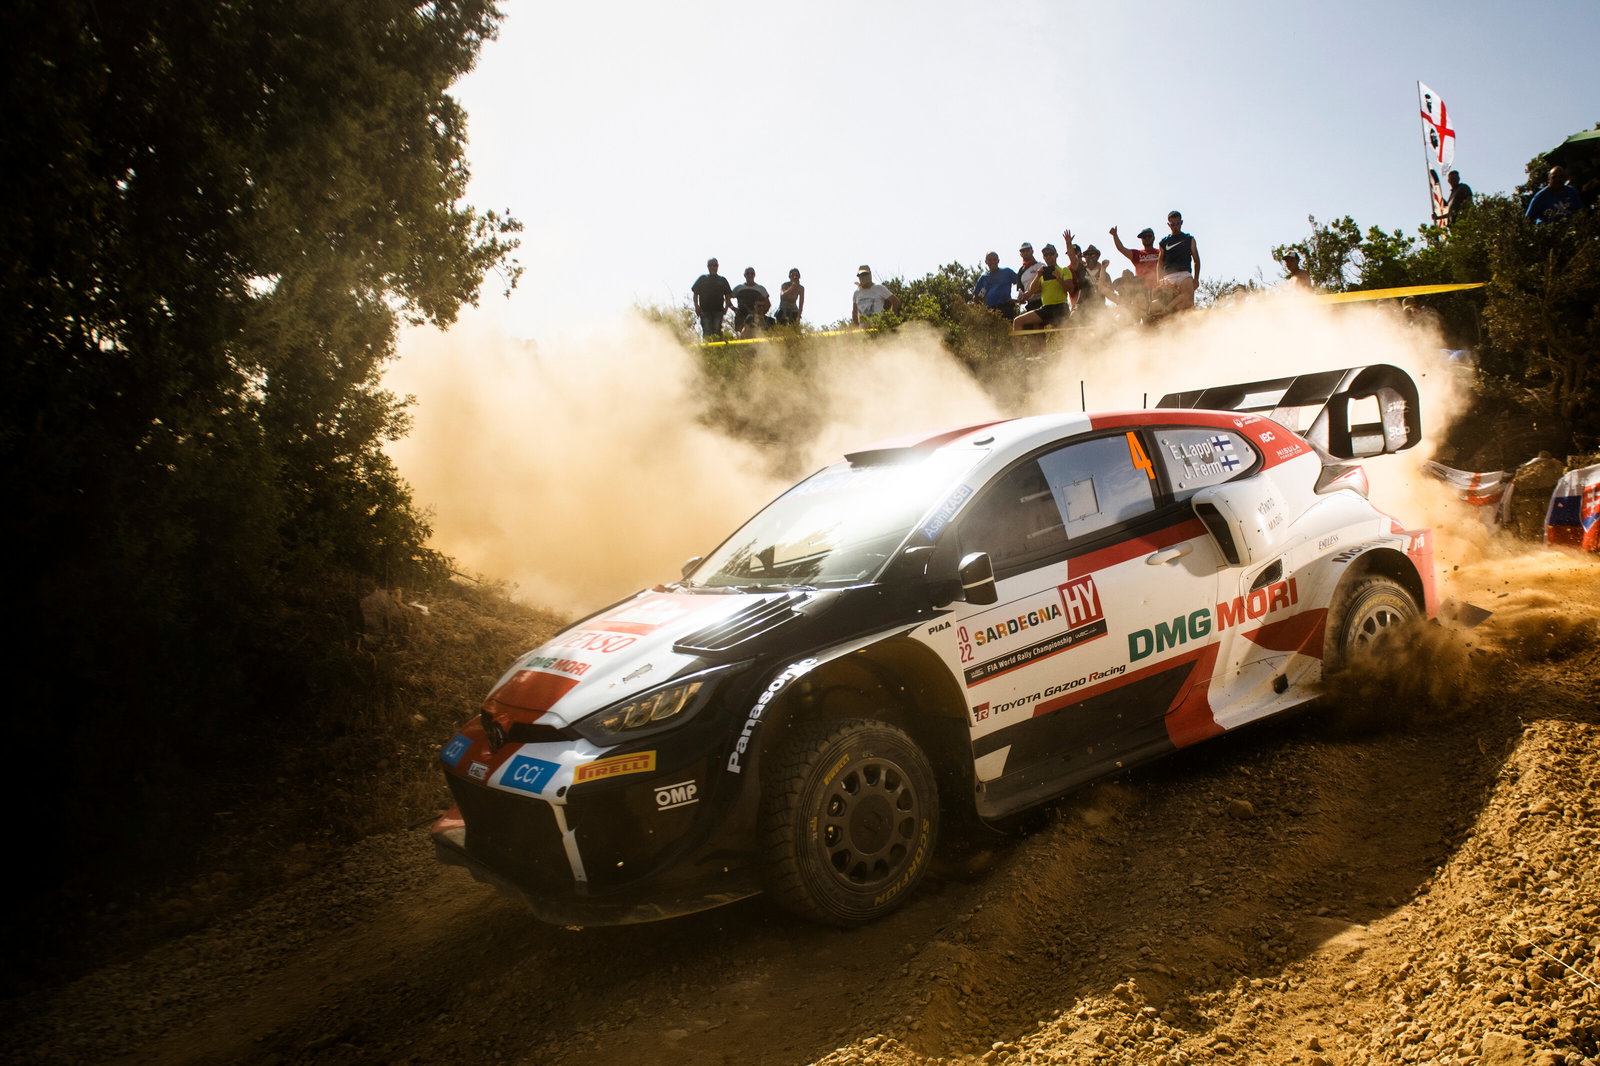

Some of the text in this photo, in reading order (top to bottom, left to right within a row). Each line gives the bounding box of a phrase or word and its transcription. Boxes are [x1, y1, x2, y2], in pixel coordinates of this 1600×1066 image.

[1126, 431, 1155, 480] 4
[1170, 437, 1213, 462] E.Lappi
[1276, 445, 1300, 456] NISULA
[1182, 458, 1223, 481] J.Ferm
[1062, 580, 1097, 624] HY
[1128, 577, 1299, 663] DMG MORI
[928, 621, 952, 635] PIAA
[974, 604, 1062, 646] SARDEGNA
[551, 658, 592, 676] MORI
[986, 635, 1073, 673] FIA World Rally Championship
[992, 692, 1041, 716] TOYOTA
[1044, 677, 1086, 698] GAZOO
[1089, 662, 1126, 683] Racing
[727, 657, 818, 774] Panasonic
[579, 755, 651, 780] PIRELLI
[656, 783, 697, 806] OMP
[873, 817, 931, 906] SCORPION
